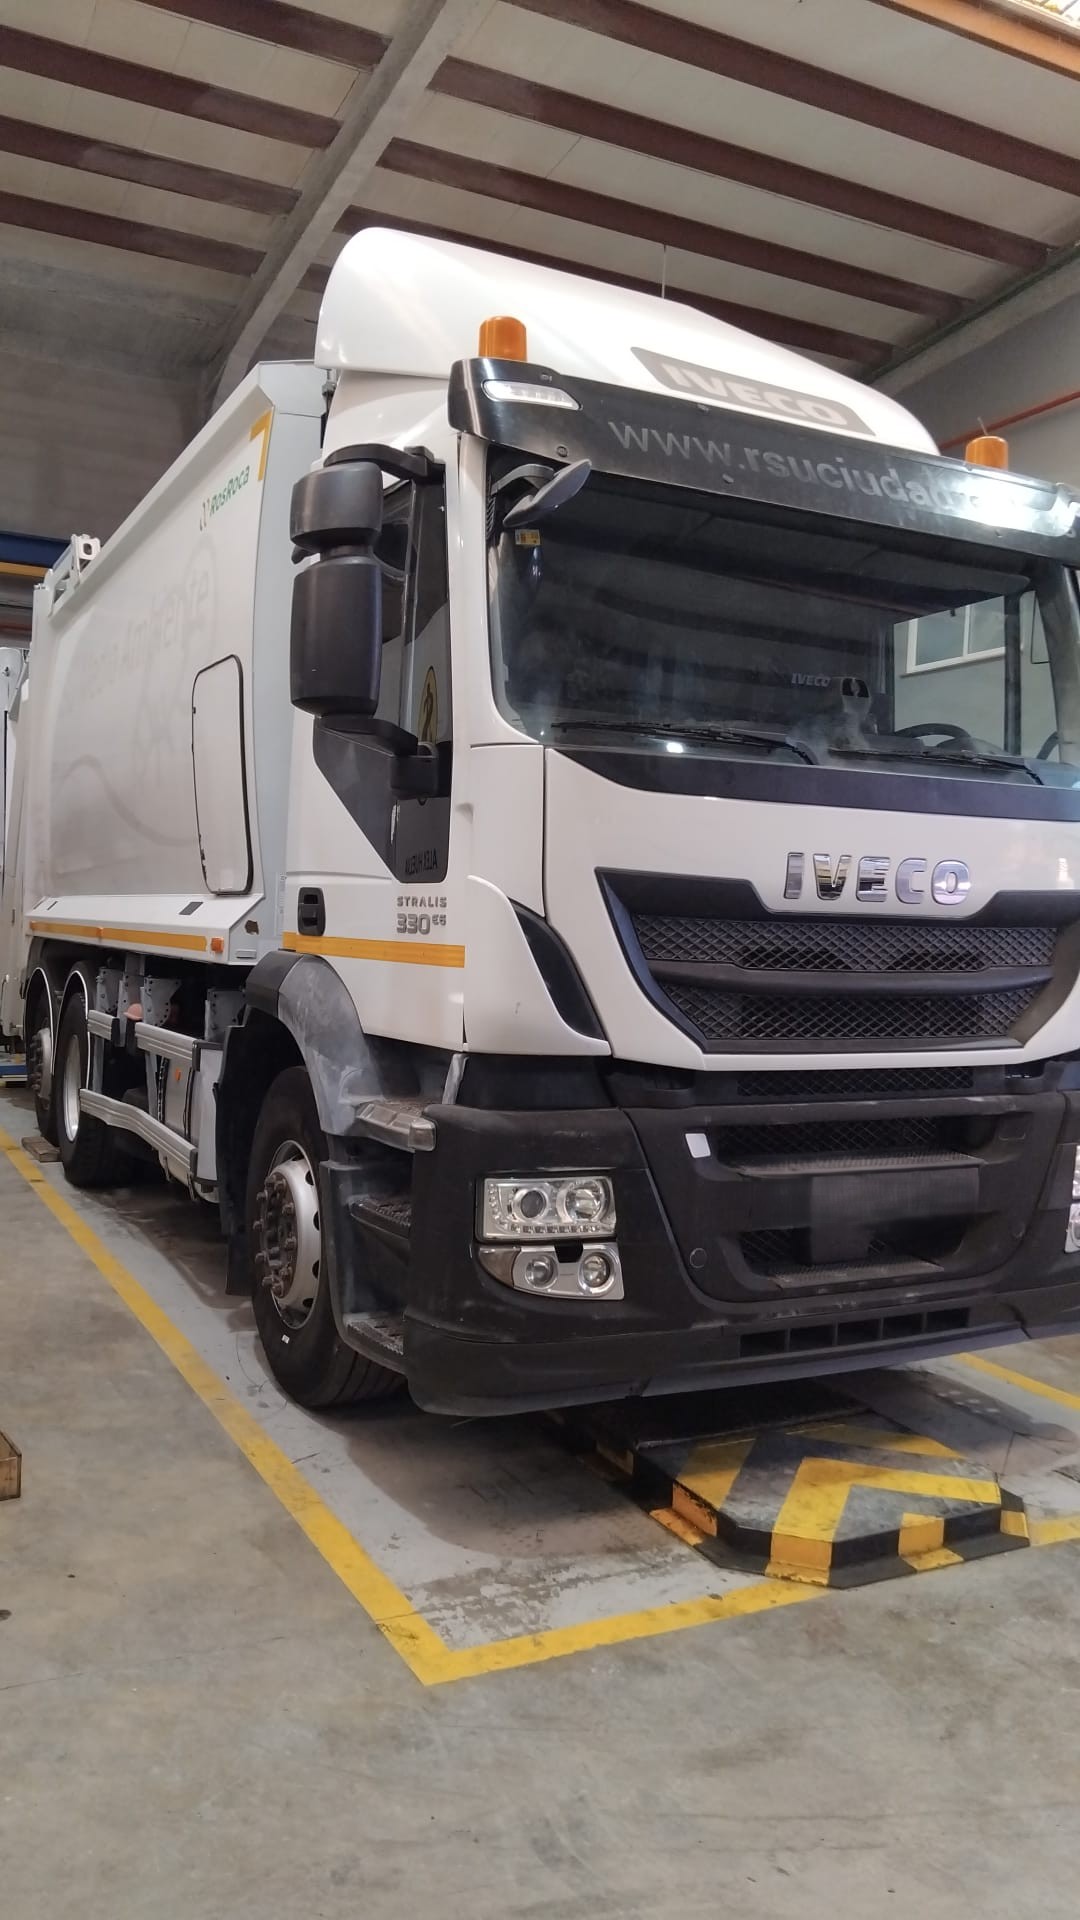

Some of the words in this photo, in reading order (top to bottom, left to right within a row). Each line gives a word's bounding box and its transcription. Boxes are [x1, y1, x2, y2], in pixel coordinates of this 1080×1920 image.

[658, 363, 850, 426] IVECO
[791, 672, 832, 688] IVECO
[783, 852, 971, 906] IVECO
[396, 895, 448, 908] STRALIS
